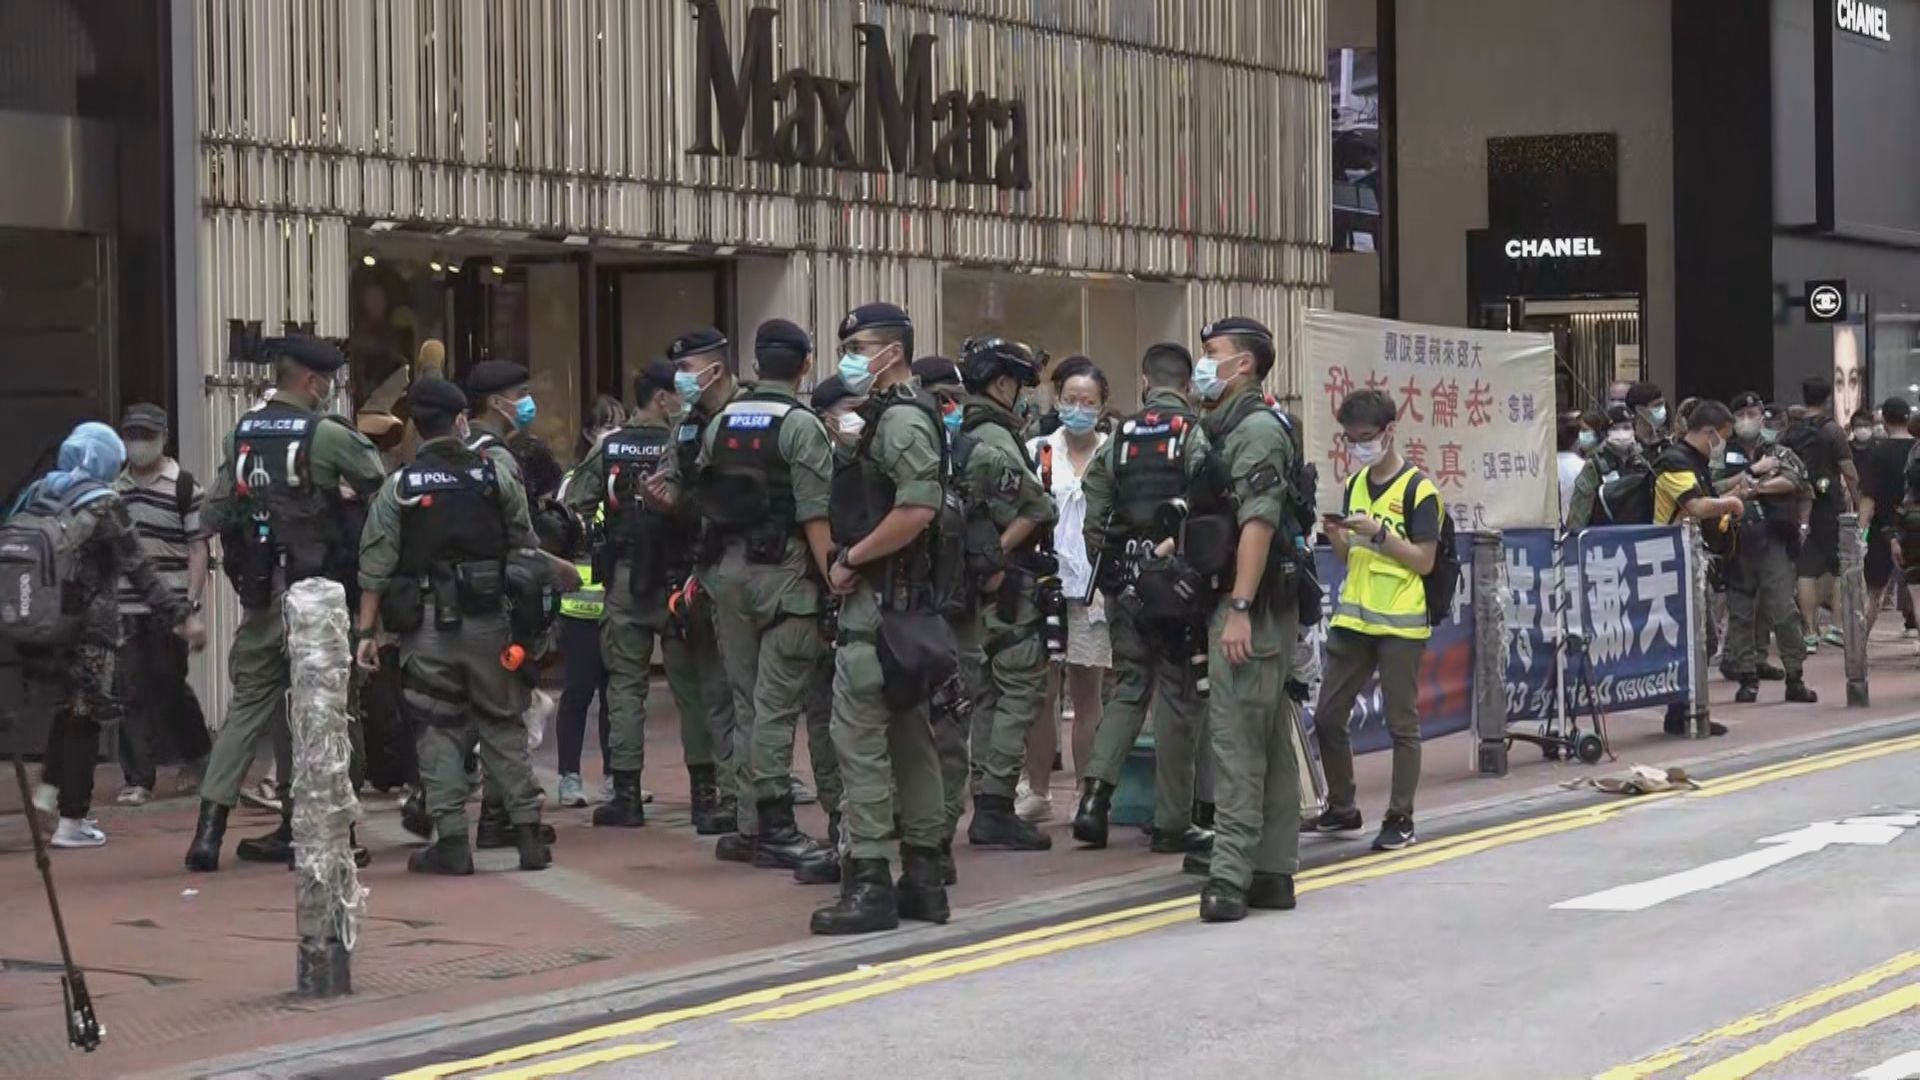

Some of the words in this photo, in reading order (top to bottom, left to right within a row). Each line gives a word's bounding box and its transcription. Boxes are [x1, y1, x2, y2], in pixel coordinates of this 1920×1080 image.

[1837, 0, 1891, 41] CHANEL
[684, 0, 1032, 191] MaxMara
[1505, 238, 1602, 258] CHANEL
[252, 420, 292, 430] POLICE
[620, 444, 660, 455] POLICE
